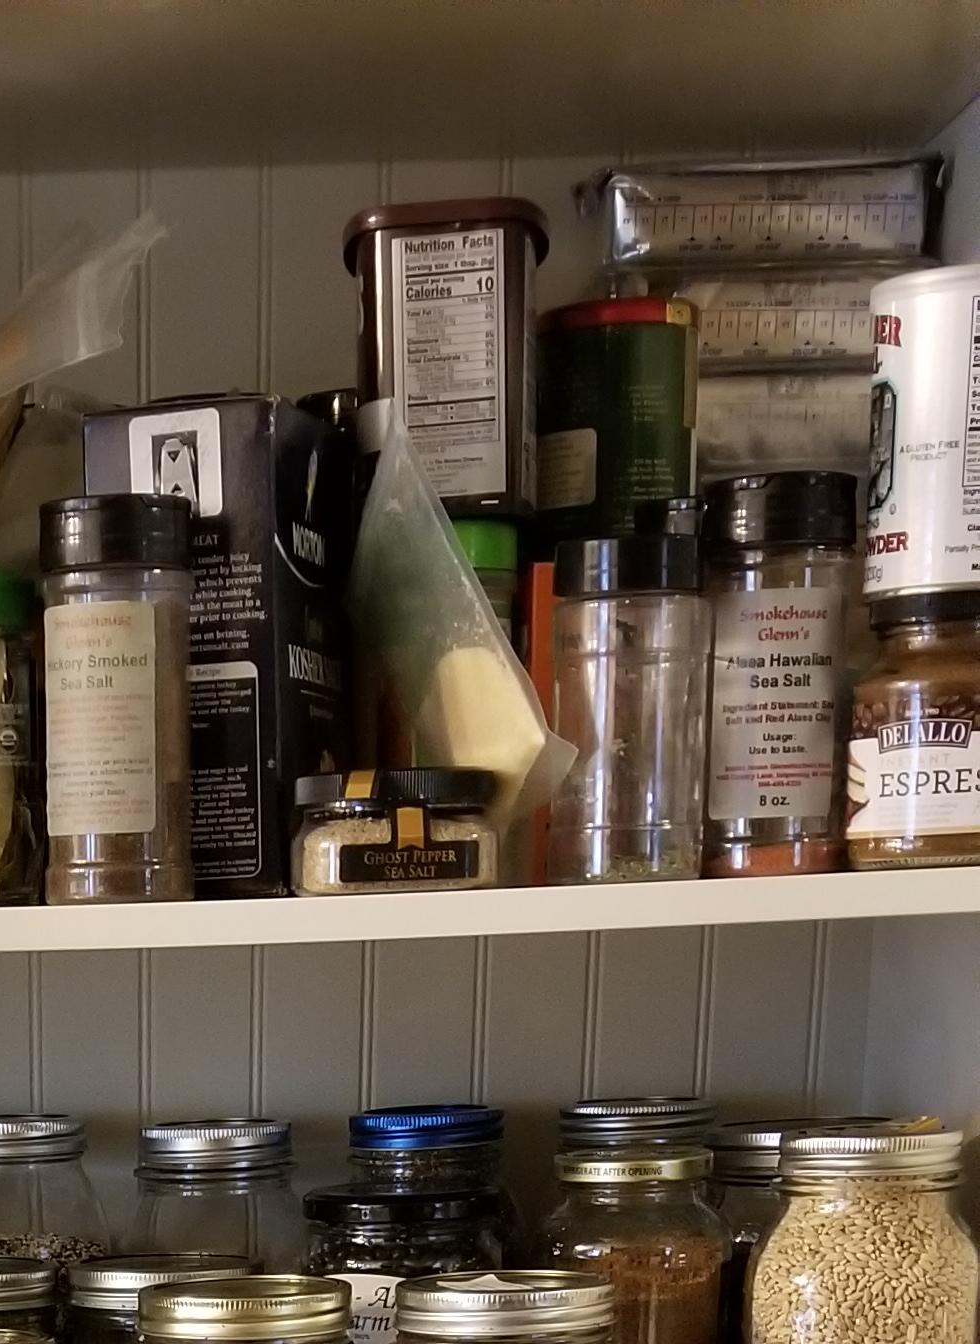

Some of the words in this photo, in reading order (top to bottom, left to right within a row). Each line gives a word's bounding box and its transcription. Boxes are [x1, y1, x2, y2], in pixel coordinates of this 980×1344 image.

[405, 238, 455, 253] Nutrition
[463, 235, 494, 249] Facts
[406, 285, 452, 299] Calories
[476, 276, 494, 292] 10
[939, 440, 960, 449] FREE
[740, 606, 828, 622] Smokehouse
[758, 628, 810, 641] Glenn's
[88, 654, 148, 669] Smoked
[770, 653, 832, 667] Hawaiian
[86, 676, 113, 689] Salt
[750, 675, 779, 689] Sea
[783, 674, 811, 687] Salt
[881, 721, 968, 749] DELALLO
[759, 796, 766, 806] 8
[771, 796, 790, 806] oz.
[364, 850, 408, 866] GHOST
[413, 848, 457, 863] PEPPER
[384, 865, 405, 879] SEA
[408, 864, 437, 878] SALT
[602, 1166, 627, 1177] AFTER
[628, 1166, 663, 1177] OPENING
